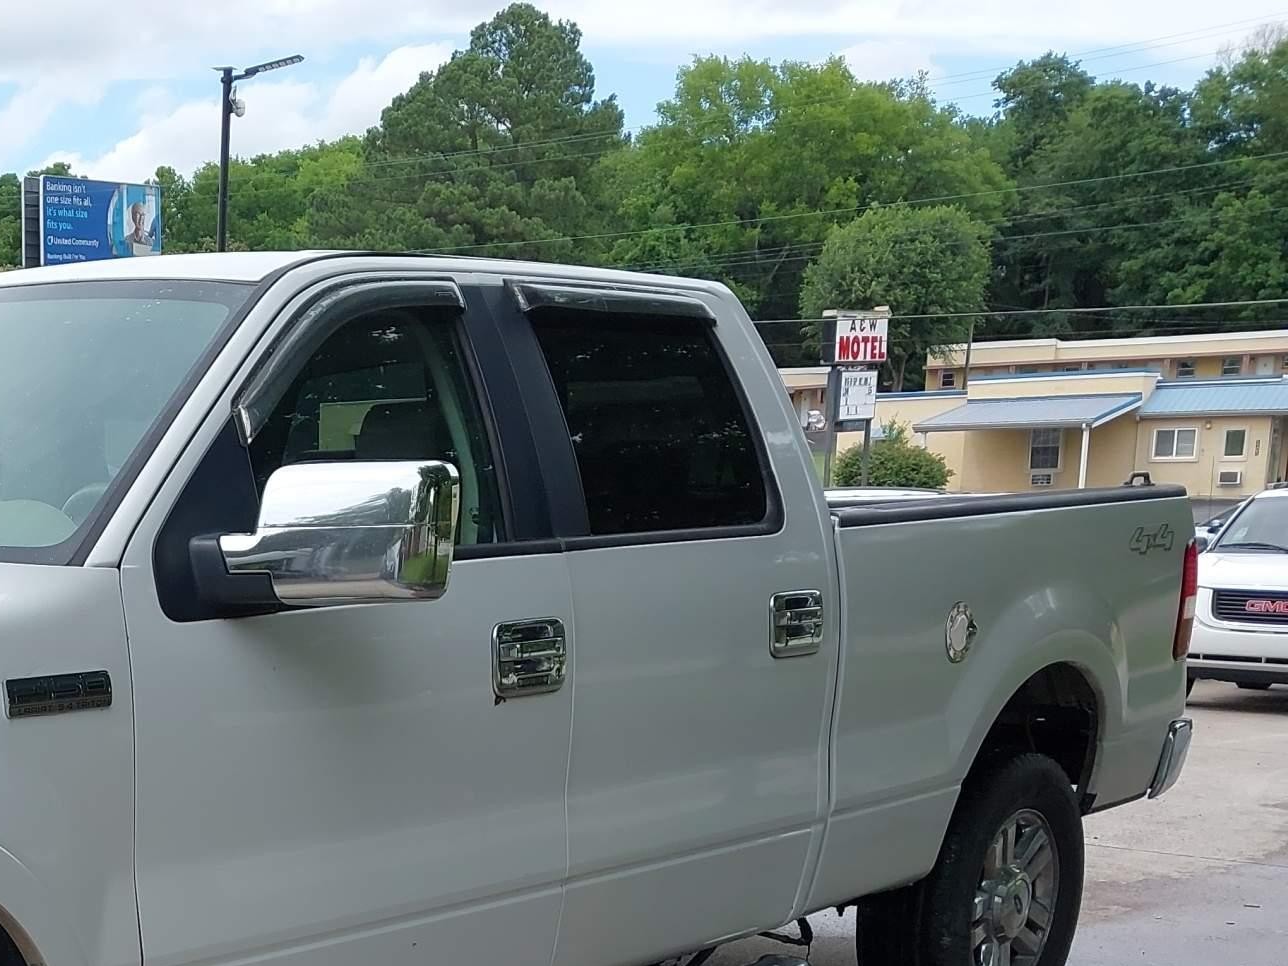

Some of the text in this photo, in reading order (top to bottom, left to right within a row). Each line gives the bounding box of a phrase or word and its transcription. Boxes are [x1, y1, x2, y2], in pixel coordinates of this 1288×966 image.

[46, 181, 86, 194] Banking isn't
[46, 196, 59, 204] one
[60, 195, 72, 205] size
[73, 195, 82, 206] fits
[58, 207, 74, 217] what
[76, 208, 88, 219] size
[46, 219, 58, 229] fits
[54, 237, 99, 248] United Community
[850, 320, 857, 333] A
[869, 319, 878, 331] W
[838, 335, 886, 361] MOTEL
